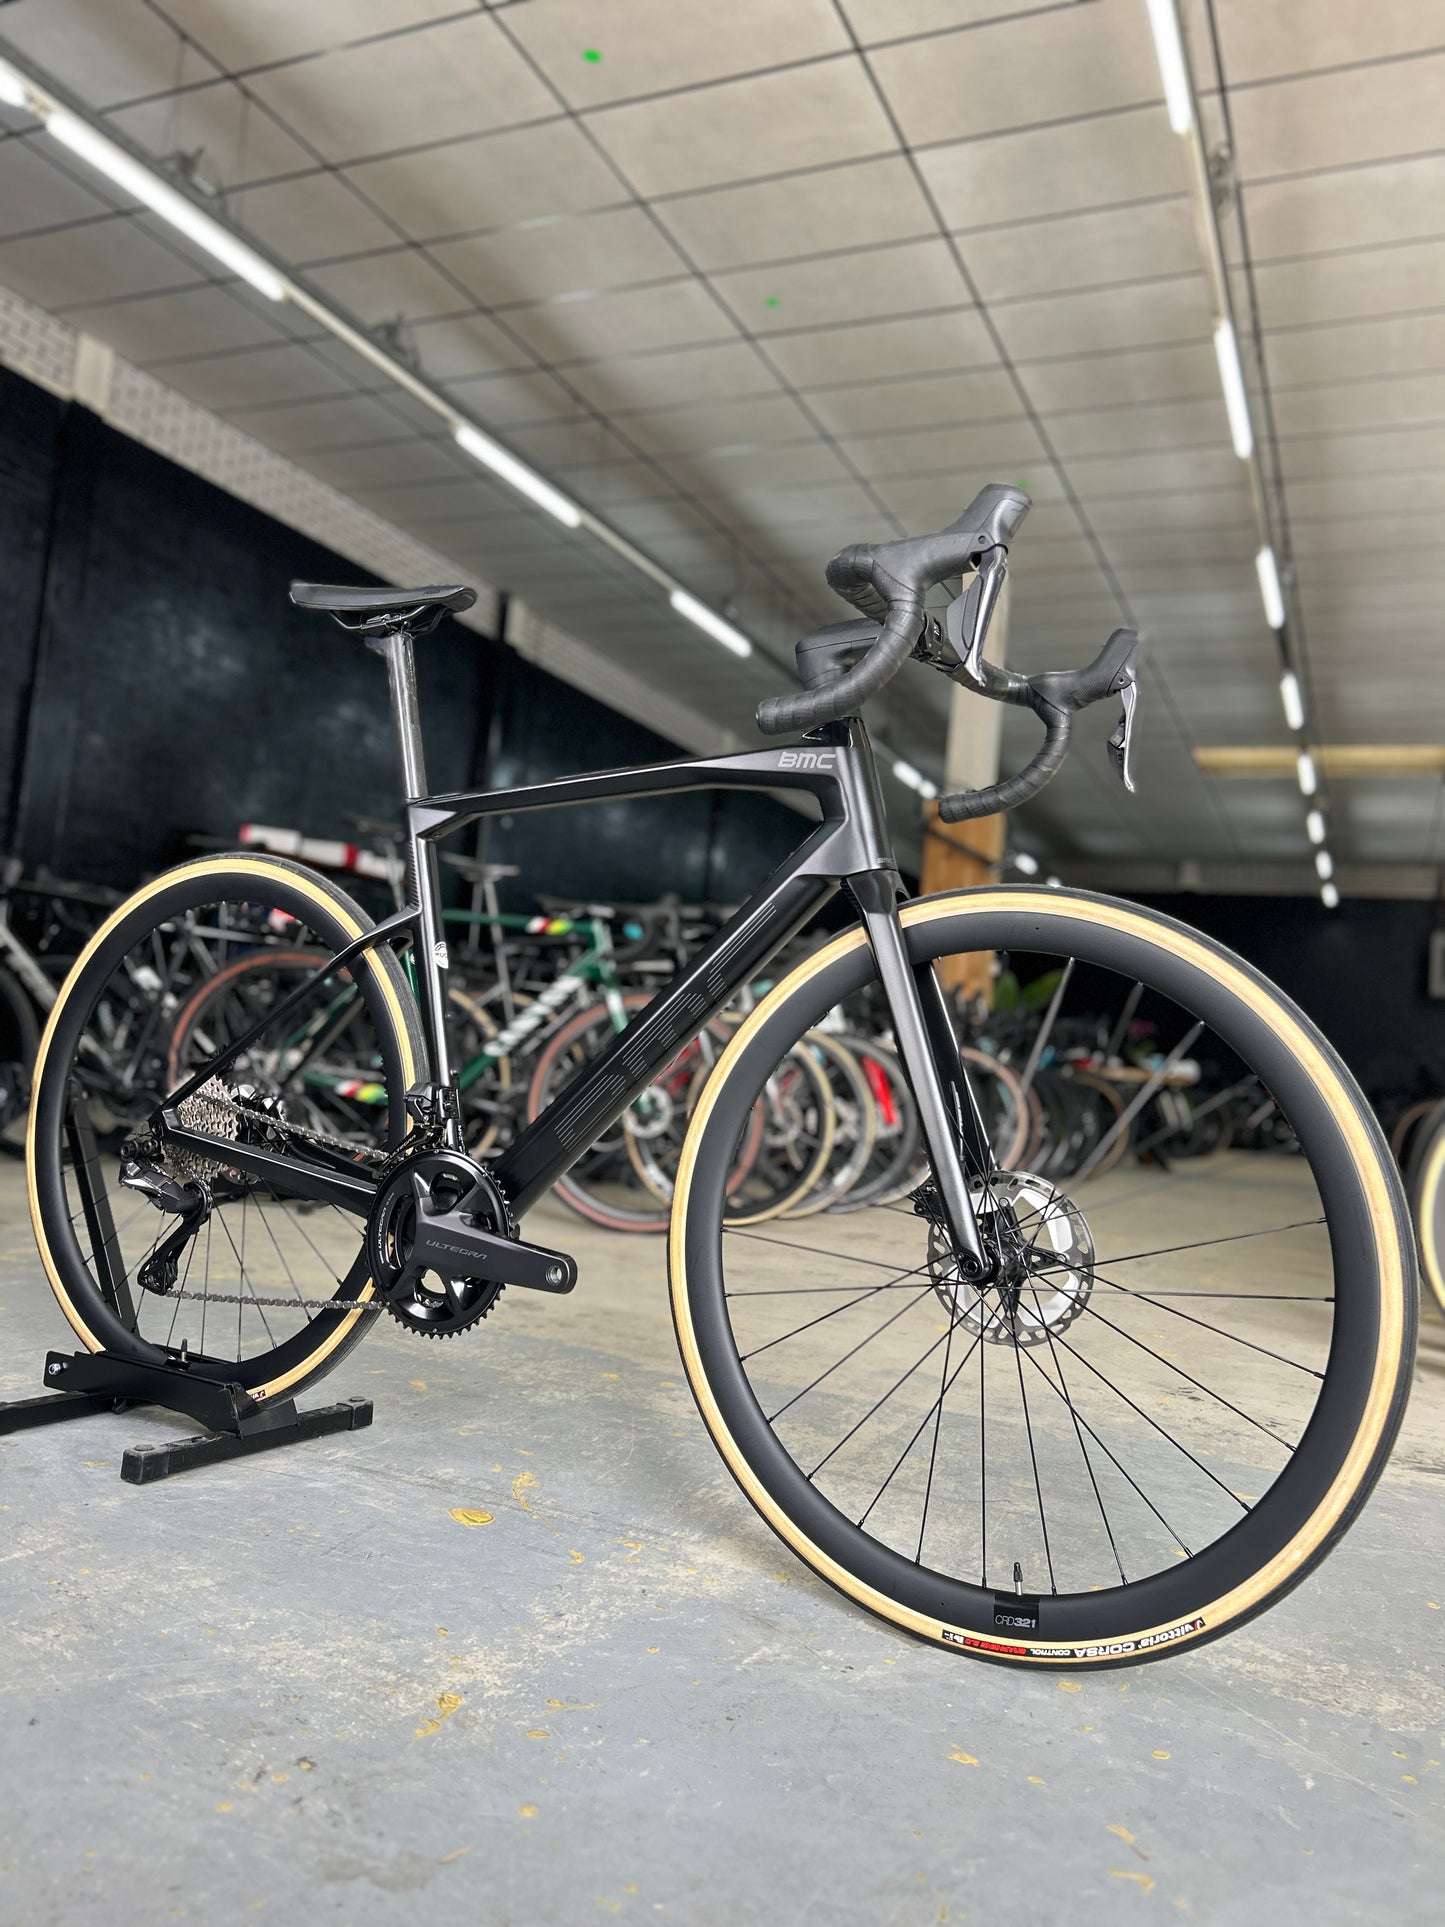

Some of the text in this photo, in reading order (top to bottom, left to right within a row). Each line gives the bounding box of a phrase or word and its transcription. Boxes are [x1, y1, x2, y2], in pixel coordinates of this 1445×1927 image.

[778, 752, 836, 769] BMC
[378, 1207, 387, 1249] ULTEGRA
[426, 1239, 488, 1260] ULTEGRA
[994, 1614, 1037, 1629] CRD321
[1030, 1648, 1071, 1656] CONTROL
[1074, 1642, 1135, 1658] CORSA
